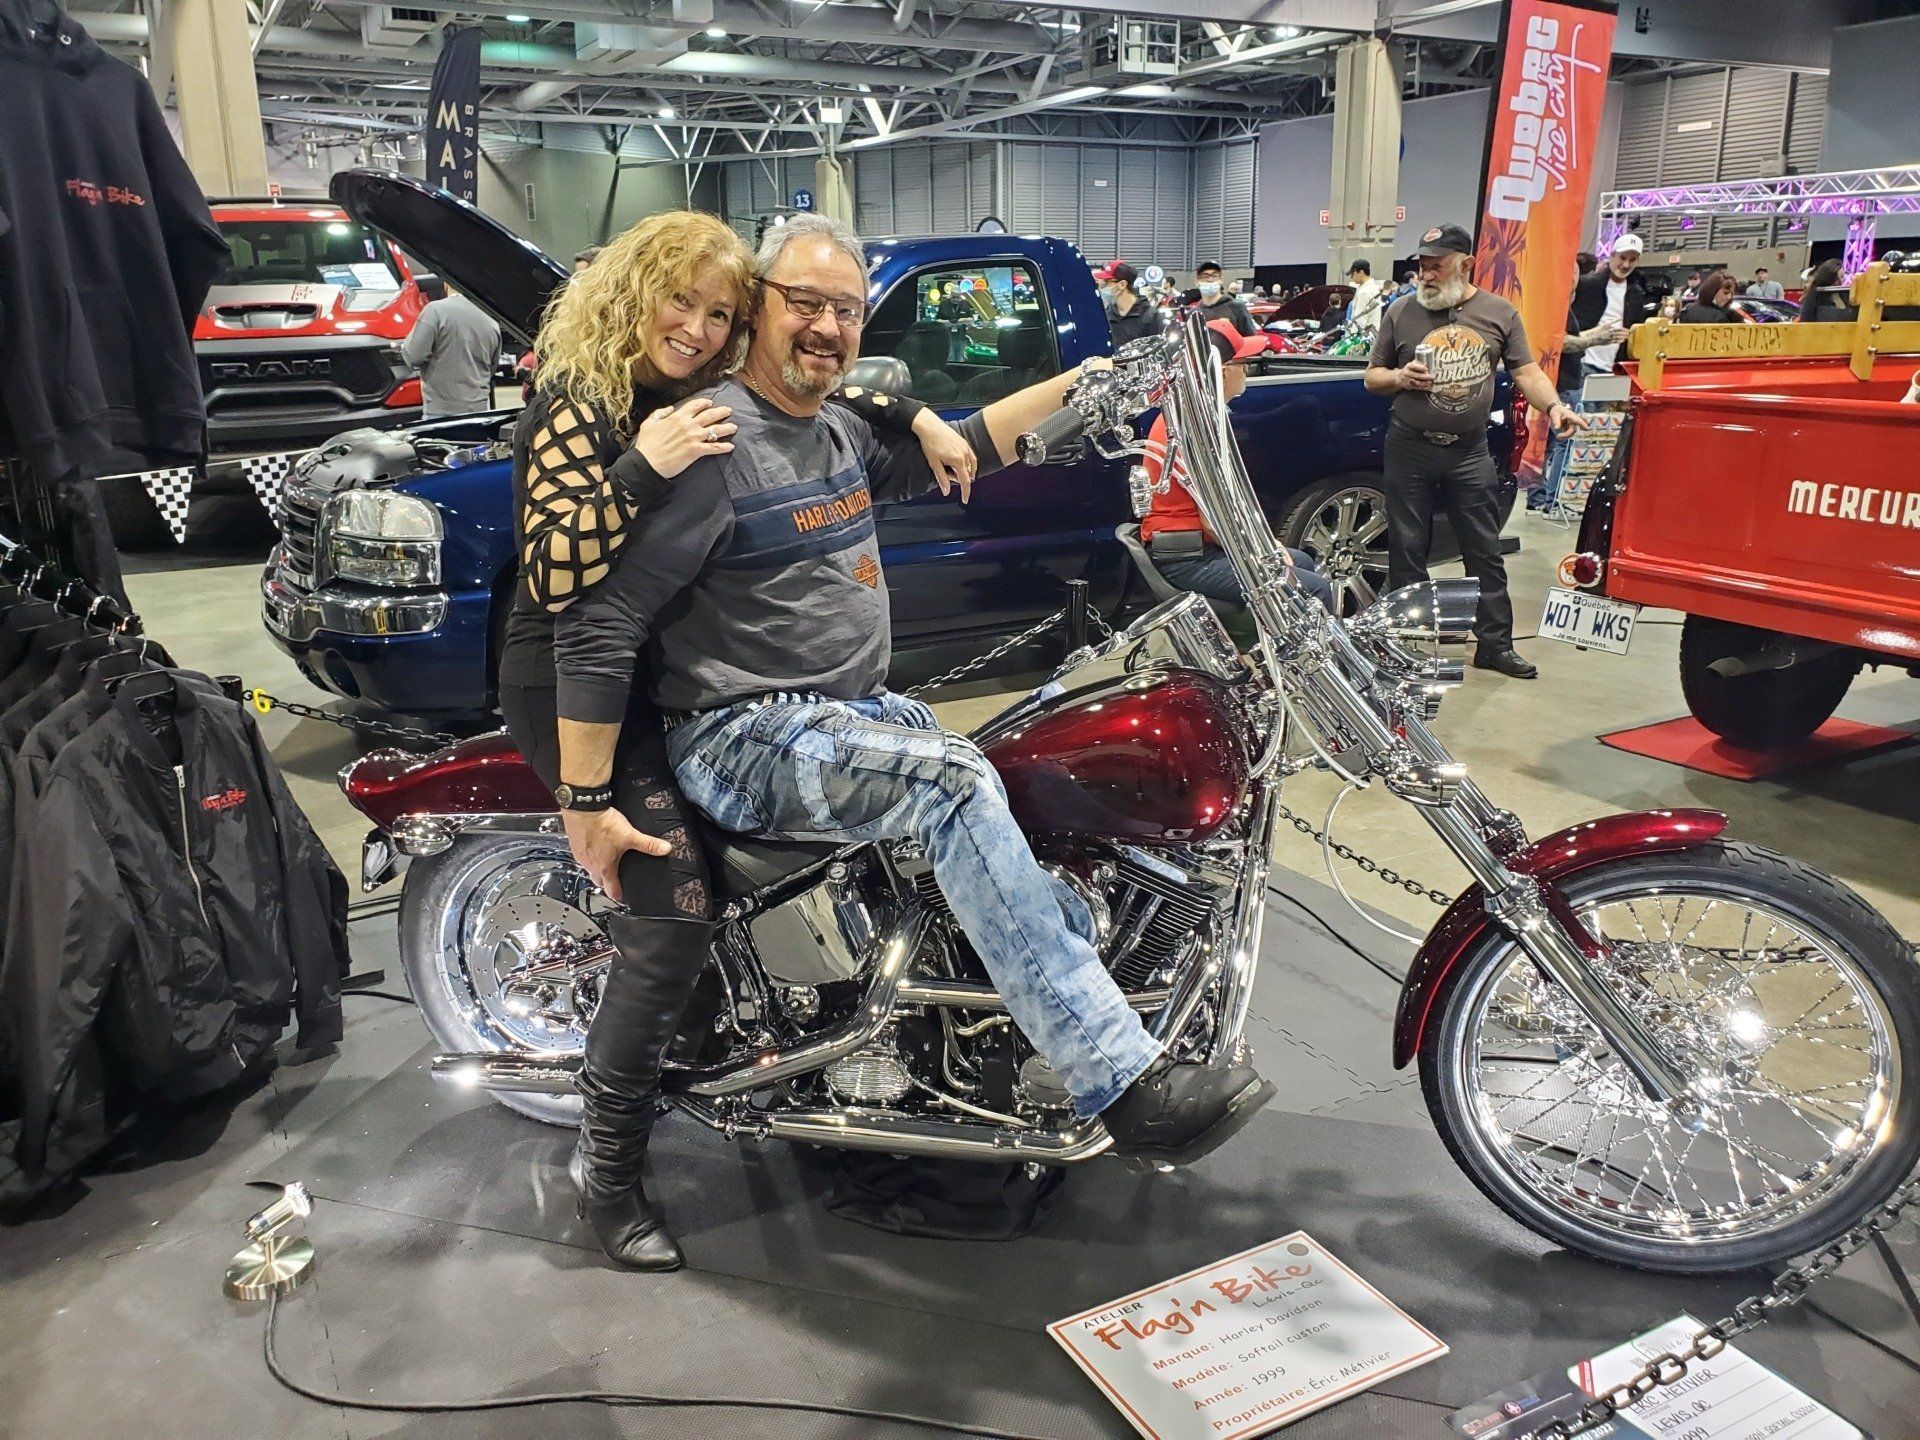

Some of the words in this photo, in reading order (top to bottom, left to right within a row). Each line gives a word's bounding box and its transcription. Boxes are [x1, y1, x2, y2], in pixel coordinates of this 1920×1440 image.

[1489, 15, 1559, 221] Quebec
[1537, 126, 1567, 190] Vice
[796, 195, 810, 207] 13
[1689, 327, 1787, 351] MERCURY
[211, 358, 331, 378] RAM
[1431, 361, 1491, 383] avidson
[1581, 598, 1611, 612] Québec
[1591, 610, 1631, 642] WKS
[1083, 1302, 1144, 1329] ATELIER
[1093, 1297, 1217, 1350] Flag'n
[1209, 1265, 1312, 1304] Bike
[1219, 1323, 1264, 1345] Harley
[1265, 1299, 1324, 1326] Davidson
[1238, 1338, 1284, 1363] Softail
[1286, 1321, 1331, 1343] custom
[1251, 1366, 1286, 1385] 1999
[1308, 1375, 1339, 1391] Éric
[1339, 1351, 1391, 1378] Métivier
